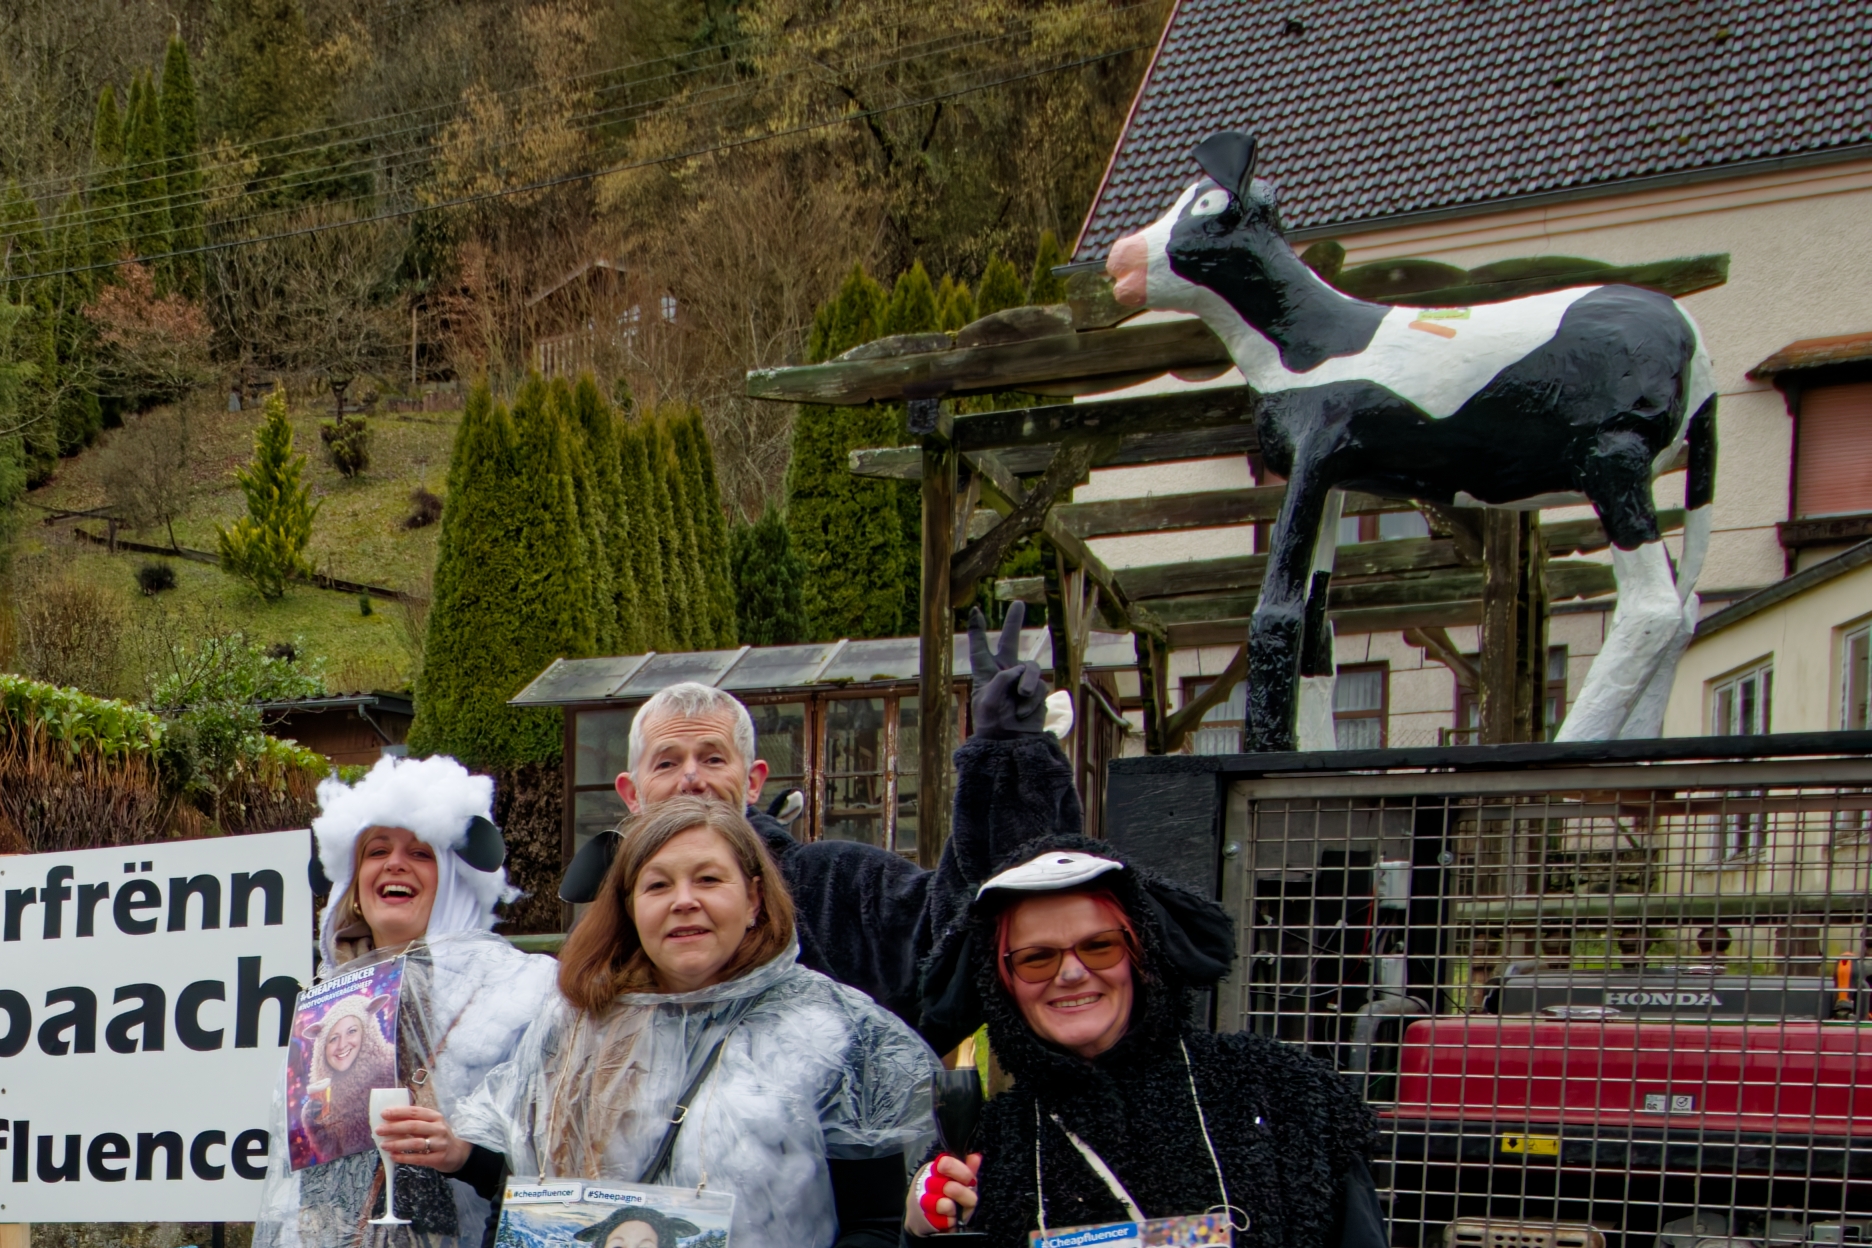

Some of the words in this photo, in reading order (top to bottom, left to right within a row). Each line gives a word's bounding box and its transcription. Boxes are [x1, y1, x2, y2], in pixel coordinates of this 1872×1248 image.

[300, 967, 375, 1001] #CHEAPFLUENCER
[1605, 992, 1723, 1006] HONDA
[513, 1189, 574, 1200] #cheapfluencer
[587, 1191, 642, 1203] #Sheepagne
